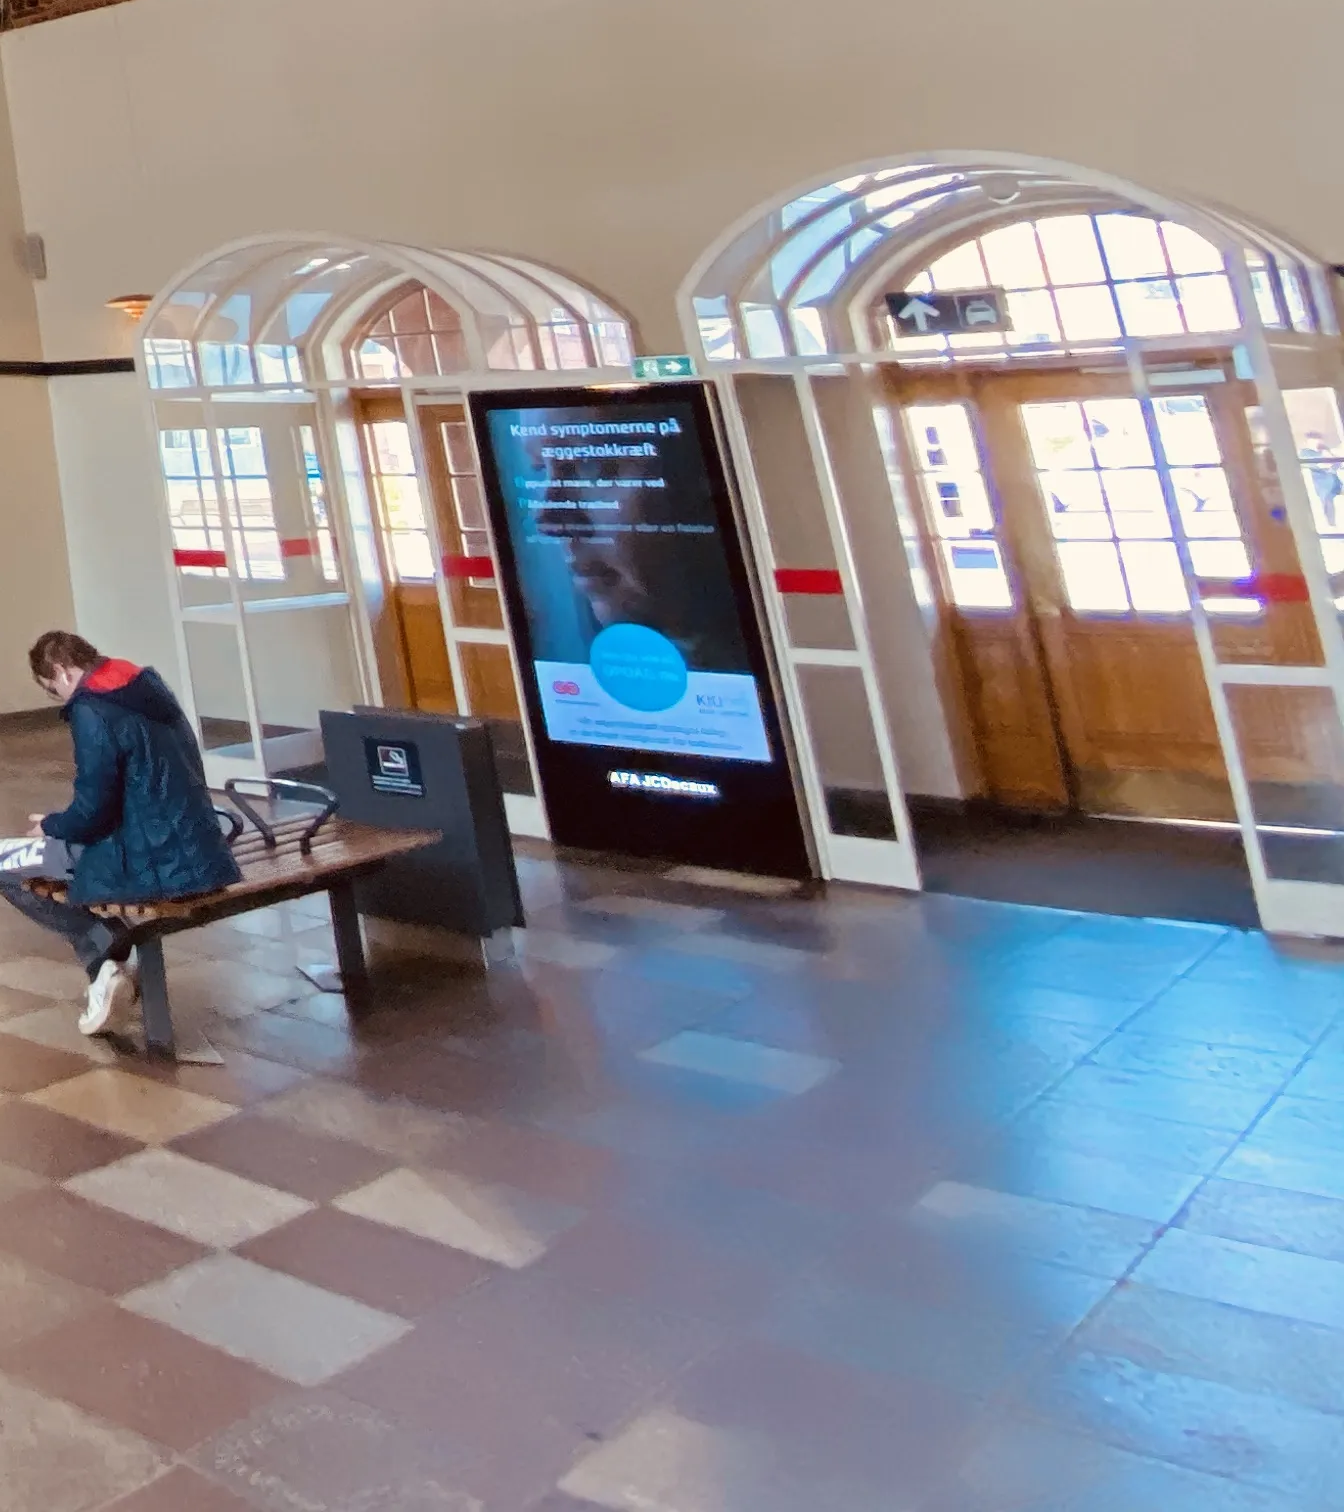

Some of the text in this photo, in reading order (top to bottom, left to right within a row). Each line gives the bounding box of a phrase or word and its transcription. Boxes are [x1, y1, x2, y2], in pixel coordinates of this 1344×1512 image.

[510, 417, 682, 440] Kend symptomerne på
[540, 441, 658, 460] æggestokkræft
[609, 771, 641, 787] AFA
